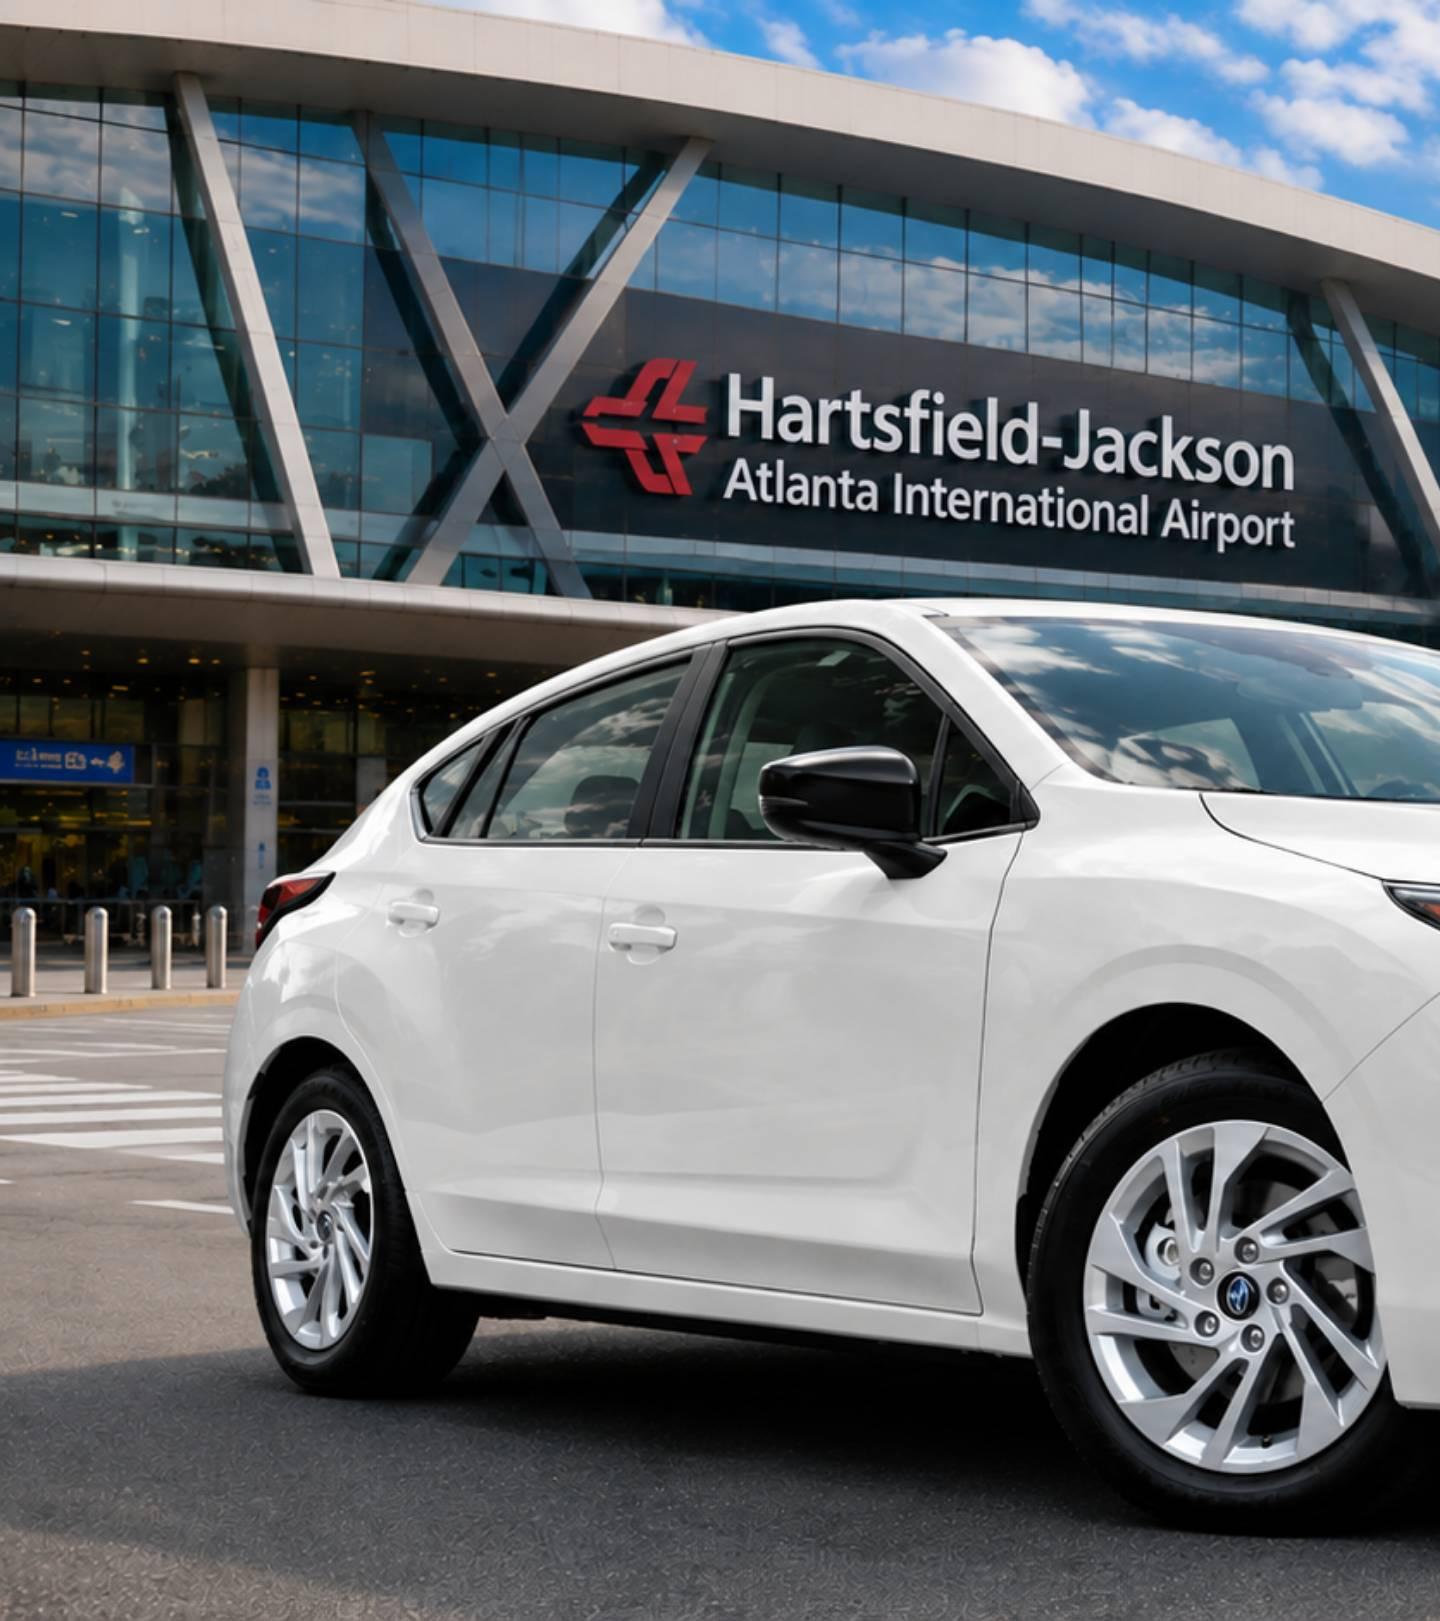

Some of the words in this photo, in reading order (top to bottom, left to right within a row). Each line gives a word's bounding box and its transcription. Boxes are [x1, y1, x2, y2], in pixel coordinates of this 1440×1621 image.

[727, 372, 1295, 492] Hartsfield-Jackson
[722, 456, 879, 512] Atlanta
[893, 471, 1149, 536] International
[1161, 497, 1296, 554] Airport
